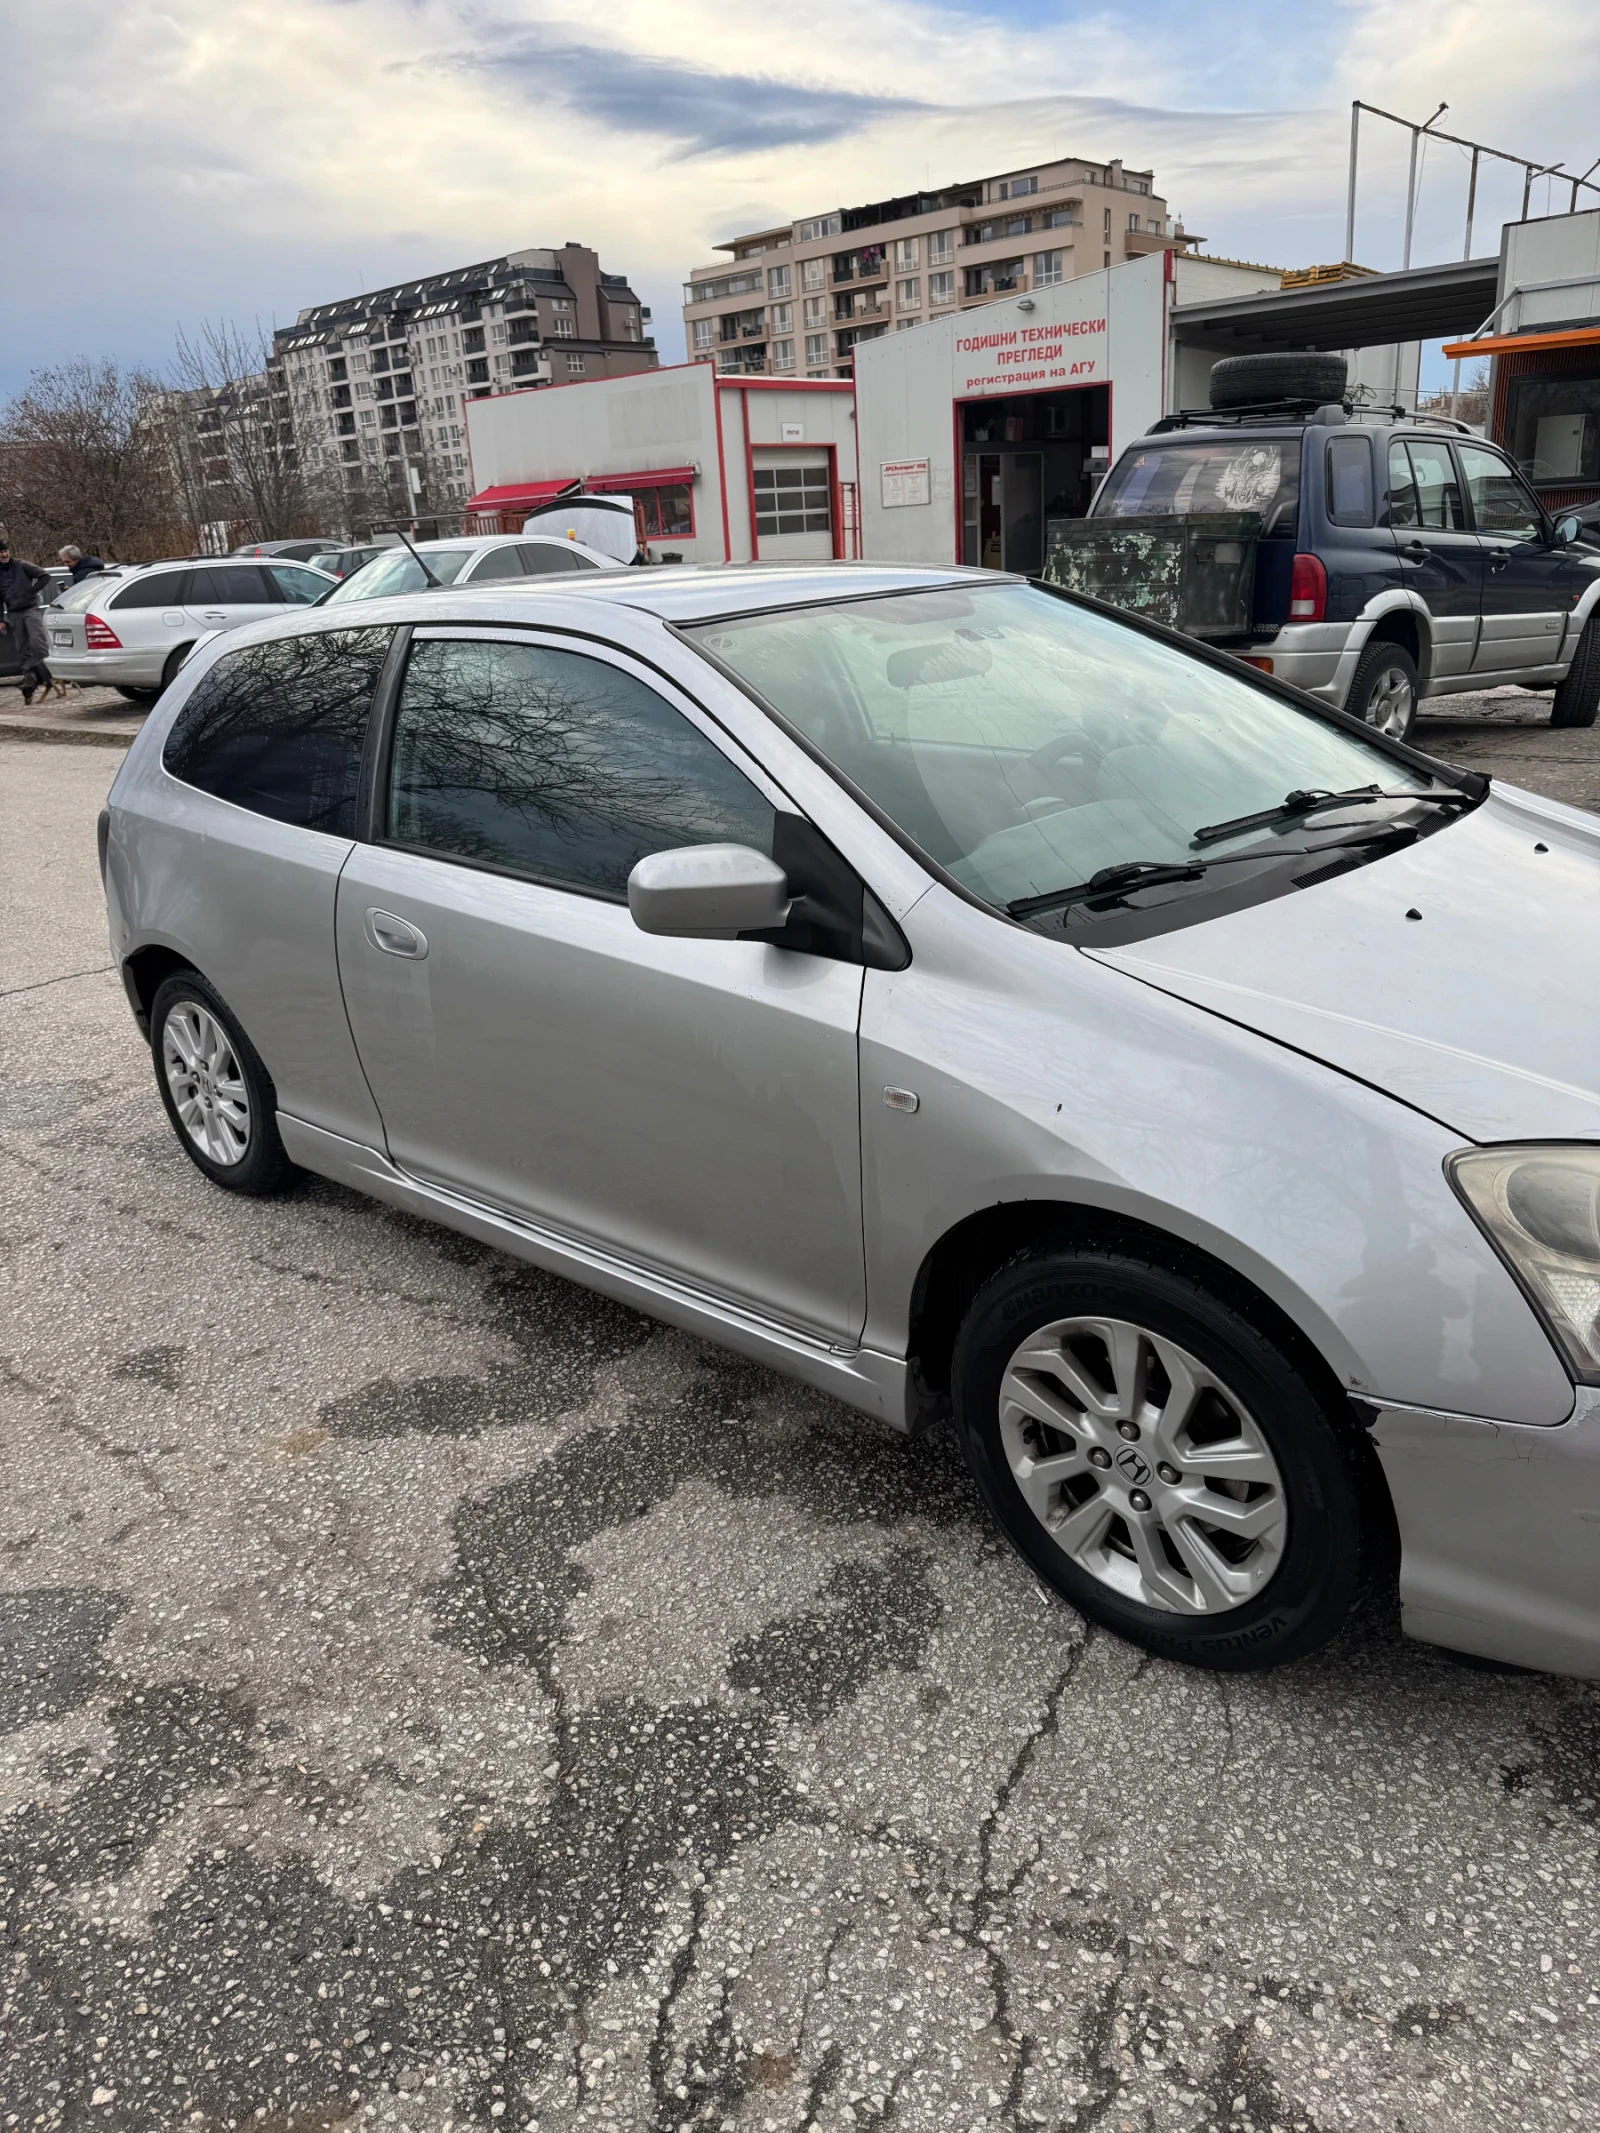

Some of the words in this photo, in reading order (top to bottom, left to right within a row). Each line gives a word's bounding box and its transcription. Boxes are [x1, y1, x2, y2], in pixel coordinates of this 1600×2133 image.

[956, 331, 1017, 352] ГОДИШНИ
[1020, 318, 1106, 342] ТЕХНИЧЕСКИ
[997, 344, 1063, 365] ПРЕГЛЕДИ
[966, 369, 1046, 389] регистрация
[1050, 366, 1066, 378] на
[1070, 360, 1096, 375] АГУ
